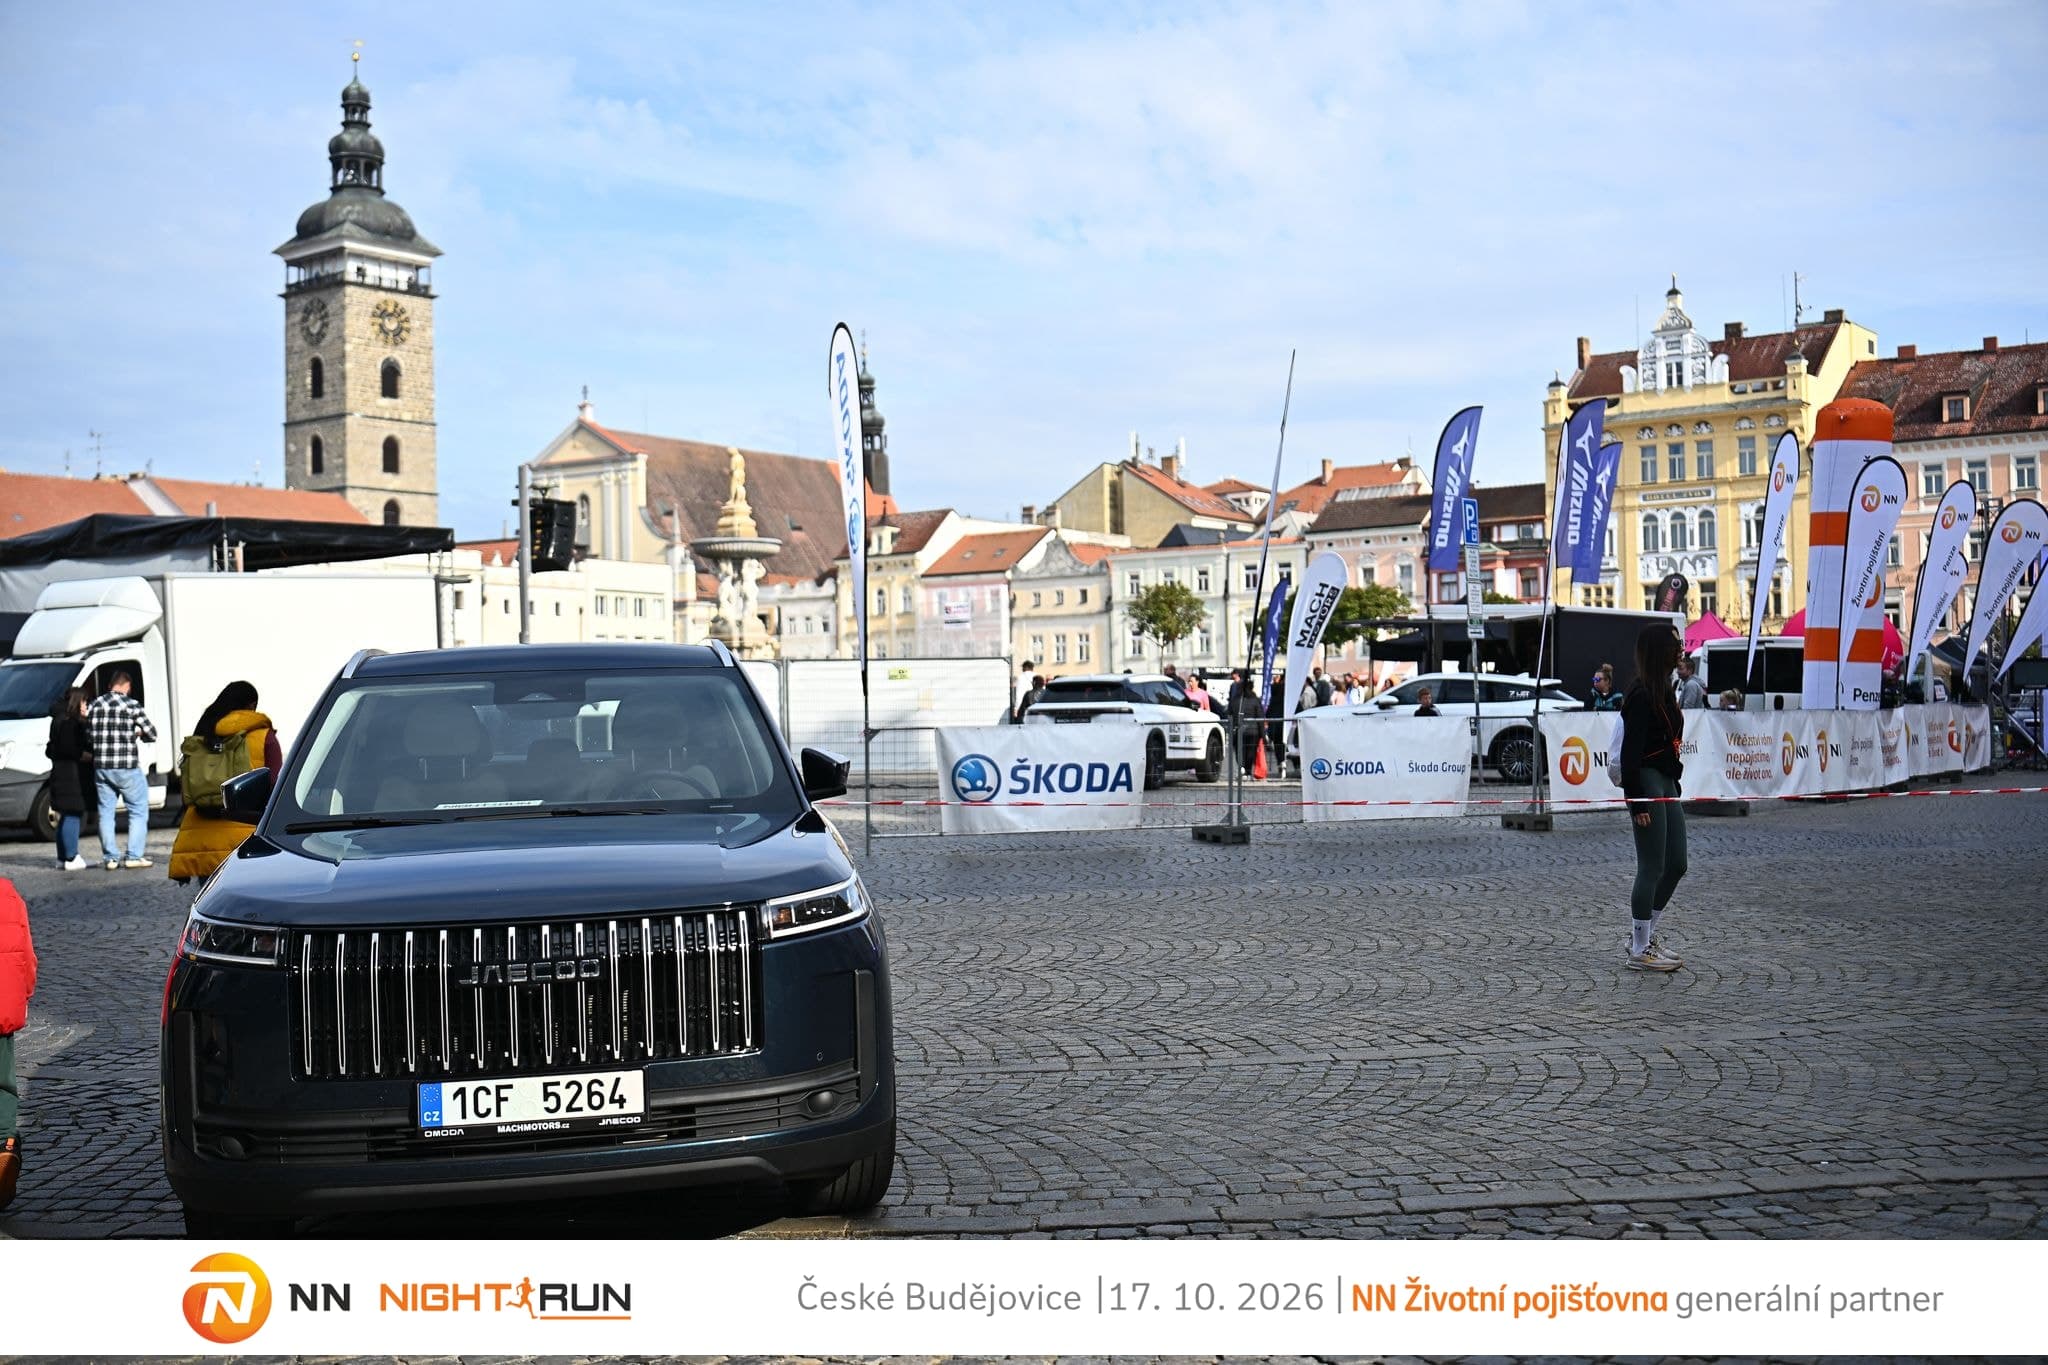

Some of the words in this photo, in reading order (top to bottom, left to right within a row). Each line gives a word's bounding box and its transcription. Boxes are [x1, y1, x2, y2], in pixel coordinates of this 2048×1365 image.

[1884, 495, 1898, 505] NN
[1957, 513, 1968, 521] NN
[2025, 530, 2041, 540] NN
[1851, 572, 1870, 608] Životní
[1866, 529, 1886, 575] pojištění
[1983, 591, 2004, 621] Životní
[2001, 558, 2024, 594] pojištění
[1295, 582, 1329, 648] MACH
[1306, 586, 1340, 648] MOTORS
[1853, 687, 1881, 703] Penz
[1795, 745, 1809, 759] NN
[1335, 758, 1385, 776] ŠKODA
[1409, 759, 1439, 774] Škoda
[1441, 761, 1467, 777] Group
[1009, 757, 1133, 795] ŠKODA
[458, 958, 600, 985] JAECOO
[452, 1083, 514, 1121] 1CF
[542, 1077, 627, 1114] 5264
[424, 1110, 440, 1122] CZ
[598, 1116, 641, 1126] JAECOO
[424, 1129, 464, 1137] OMODA
[497, 1121, 570, 1134] MACHMOTORS.cz
